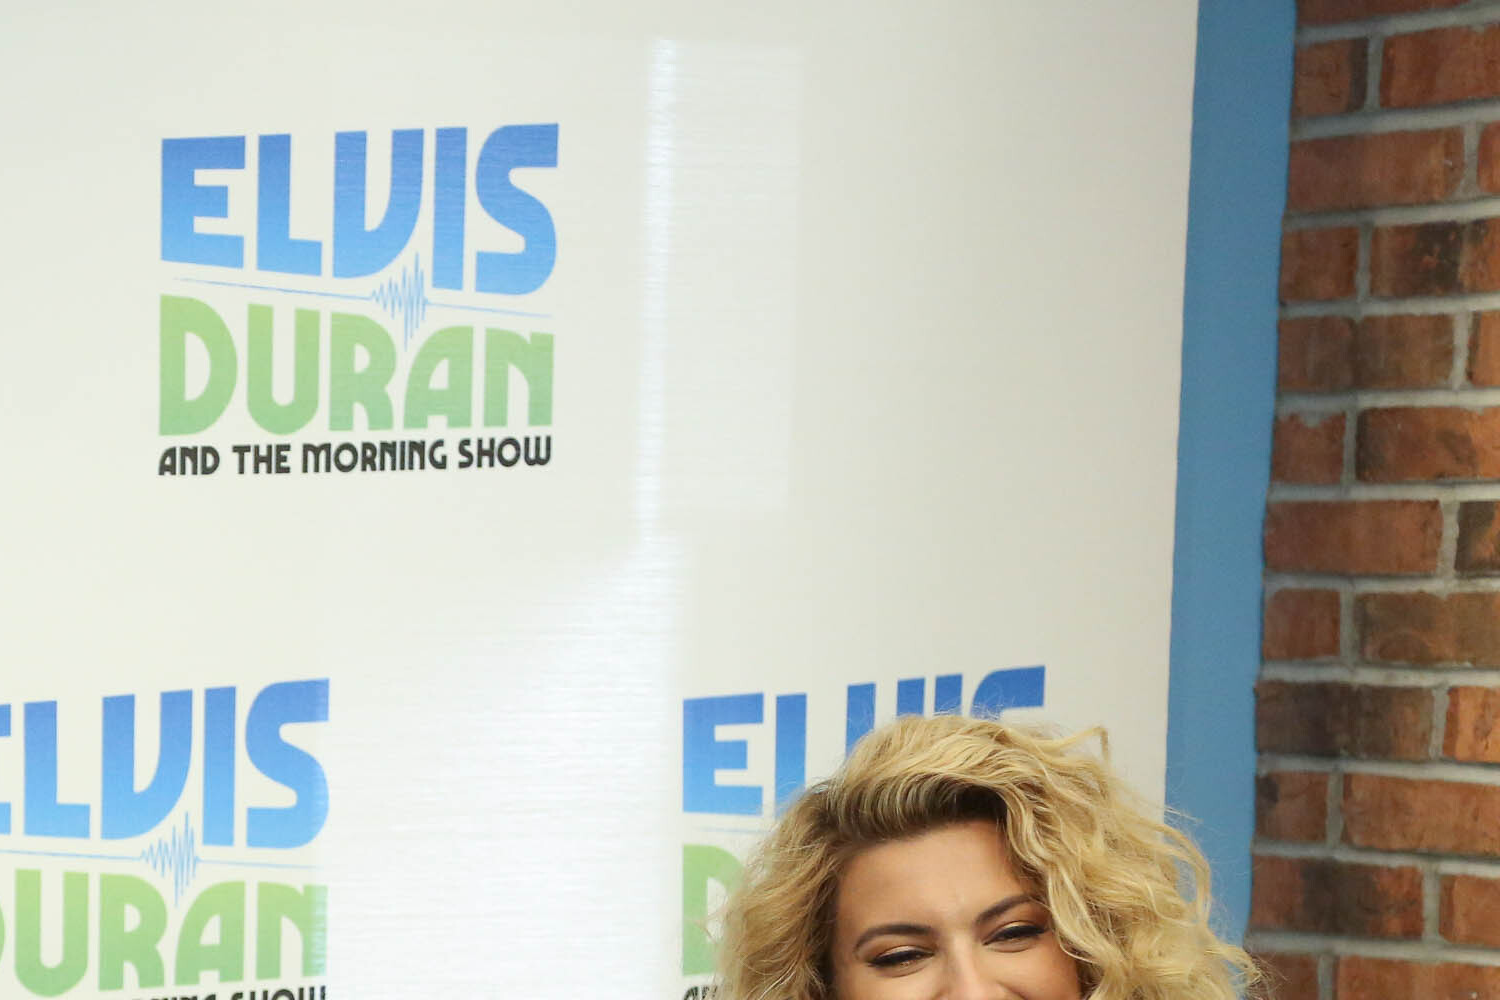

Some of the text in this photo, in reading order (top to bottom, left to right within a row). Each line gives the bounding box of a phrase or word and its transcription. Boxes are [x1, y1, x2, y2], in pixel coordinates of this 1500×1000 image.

[160, 123, 559, 295] ELVIS
[159, 293, 554, 436] DURAN
[158, 435, 552, 475] AND THE MORNING SHOW
